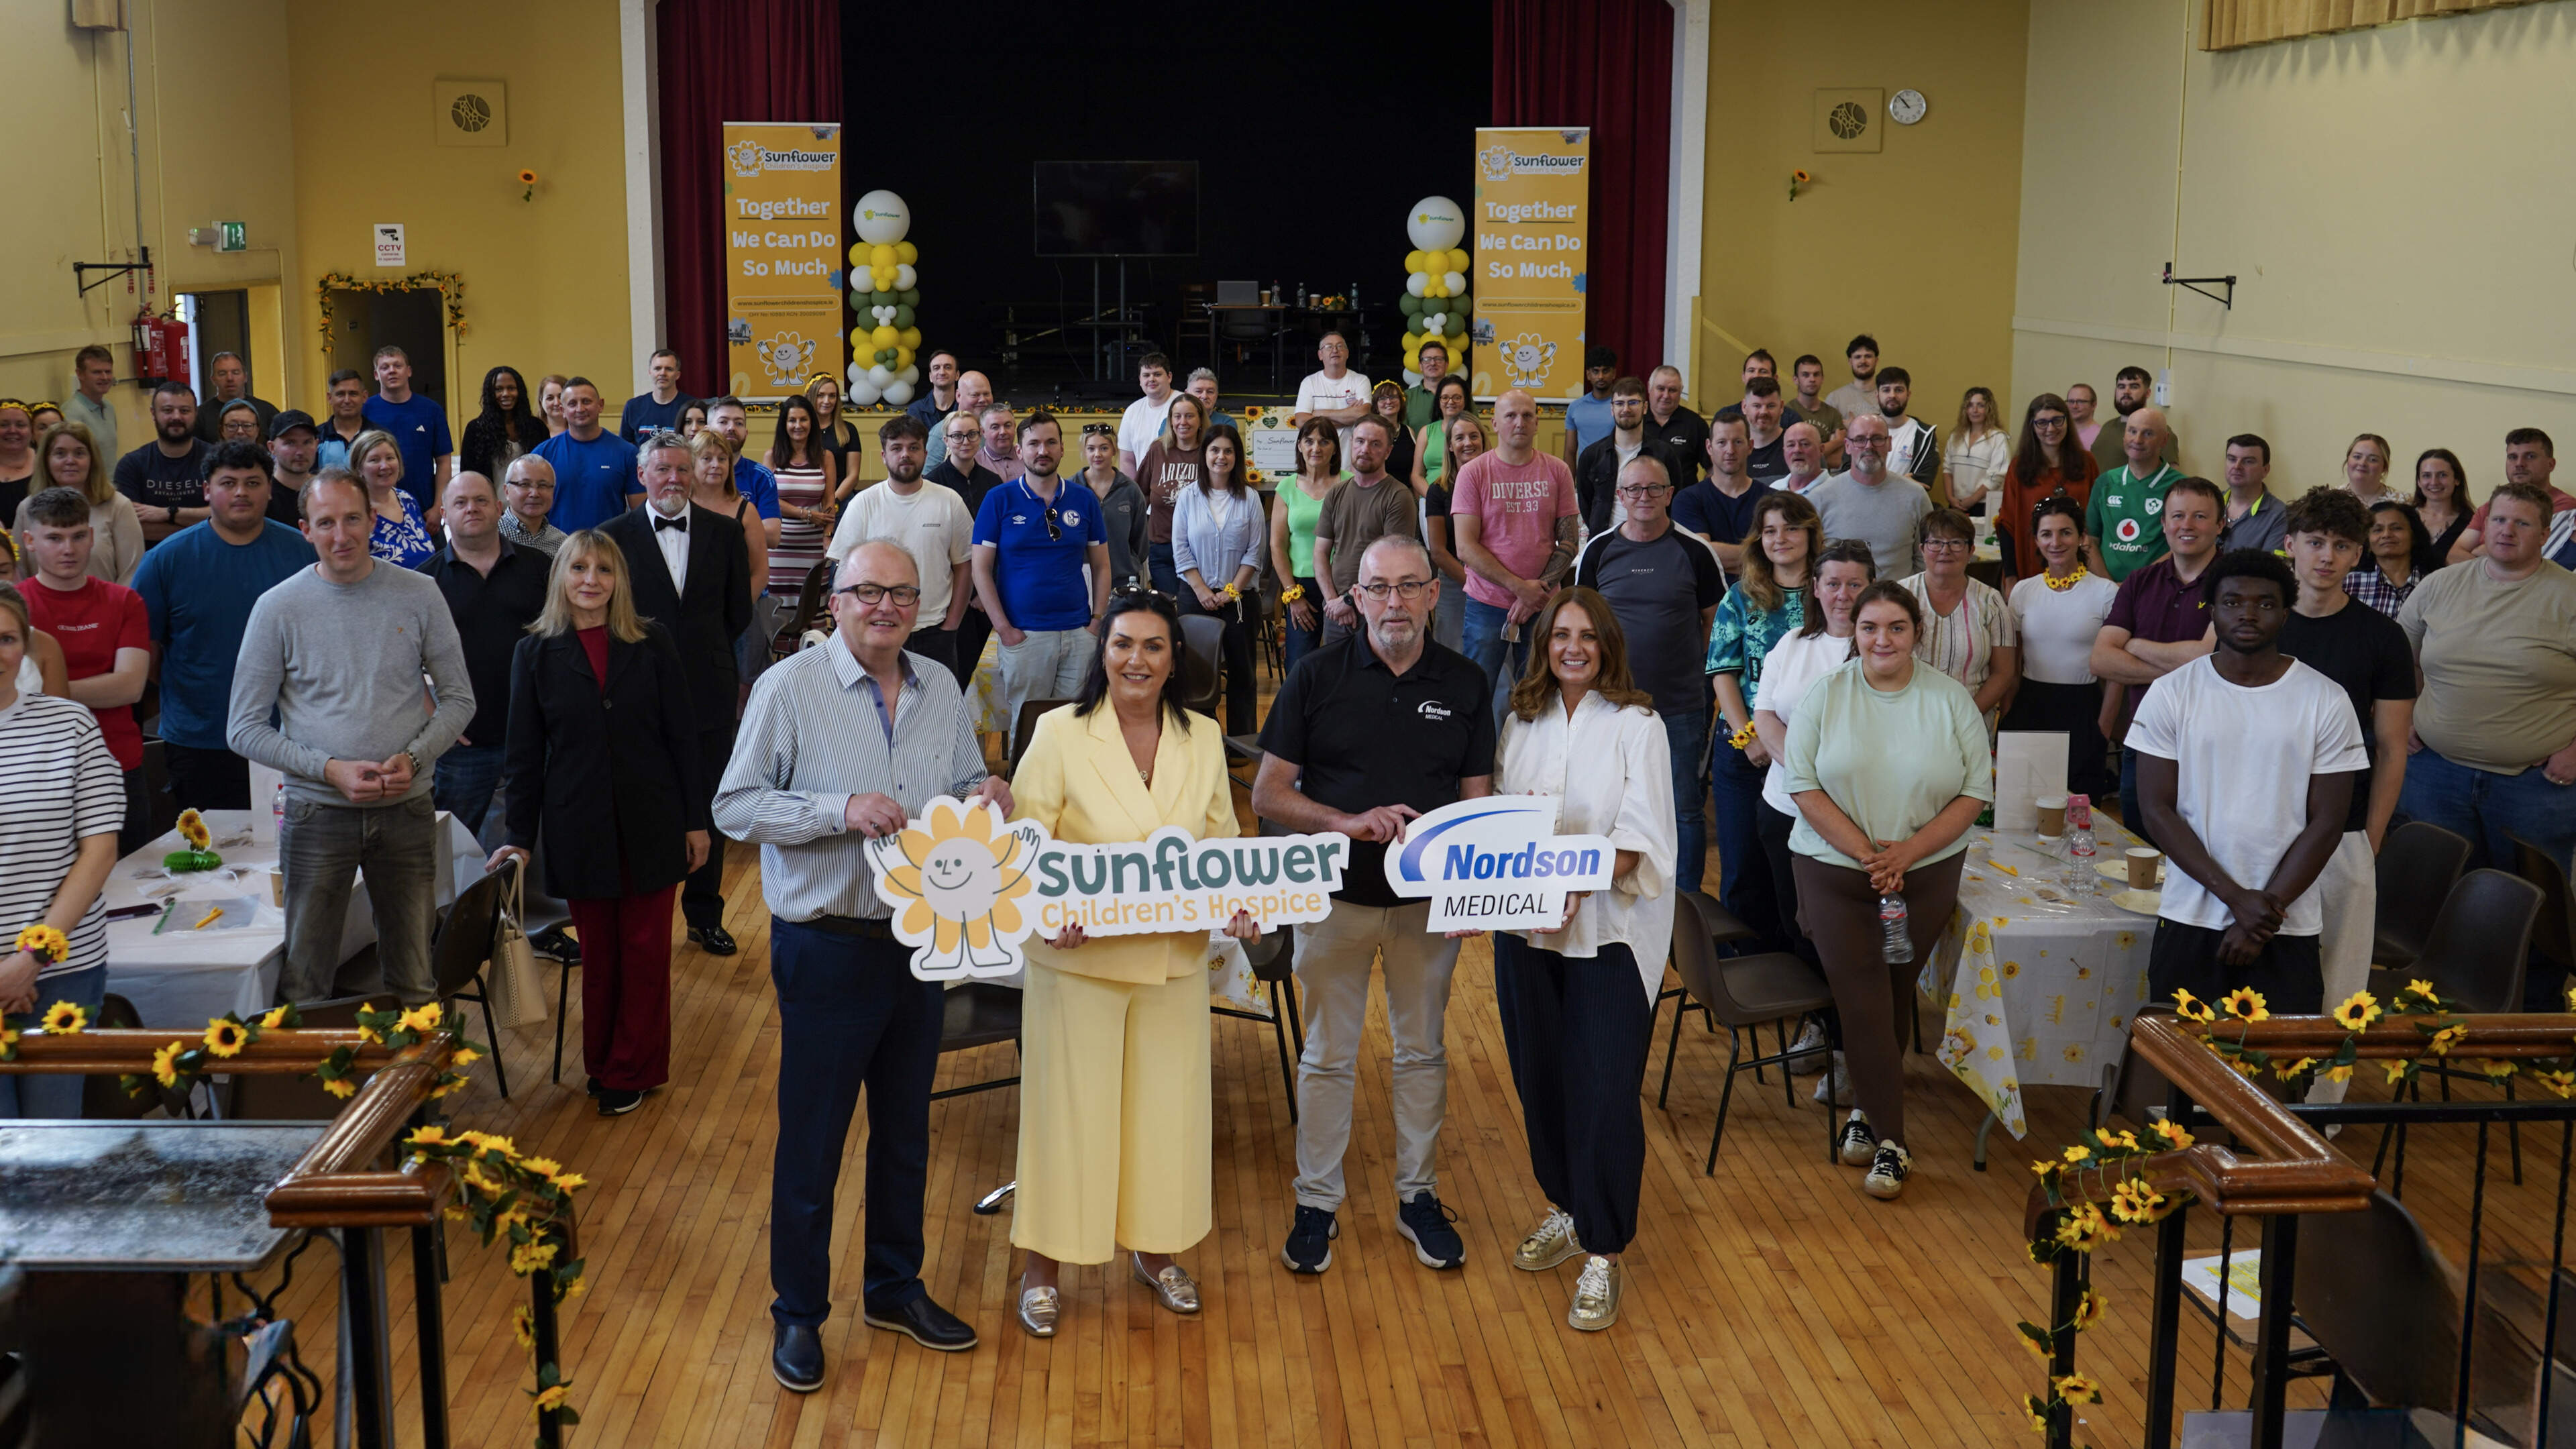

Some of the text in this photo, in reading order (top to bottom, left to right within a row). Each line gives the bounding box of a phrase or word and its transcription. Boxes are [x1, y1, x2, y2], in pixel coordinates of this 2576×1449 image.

[765, 150, 836, 162] sunflower
[1514, 154, 1585, 166] sunflower
[737, 197, 830, 220] Together
[1485, 201, 1577, 223] Together
[733, 231, 836, 248] We Can Do
[1480, 233, 1581, 250] We Can Do
[743, 258, 828, 276] So Much
[1489, 260, 1572, 278] So Much
[146, 479, 202, 490] DIESEL
[1492, 480, 1550, 499] DIVERSE
[1426, 705, 1451, 716] Nordson
[1037, 836, 1341, 897] sunflower
[1443, 841, 1601, 880] Nordson
[1041, 889, 1322, 928] Children's Hospice
[1444, 893, 1548, 917] MEDICAL
